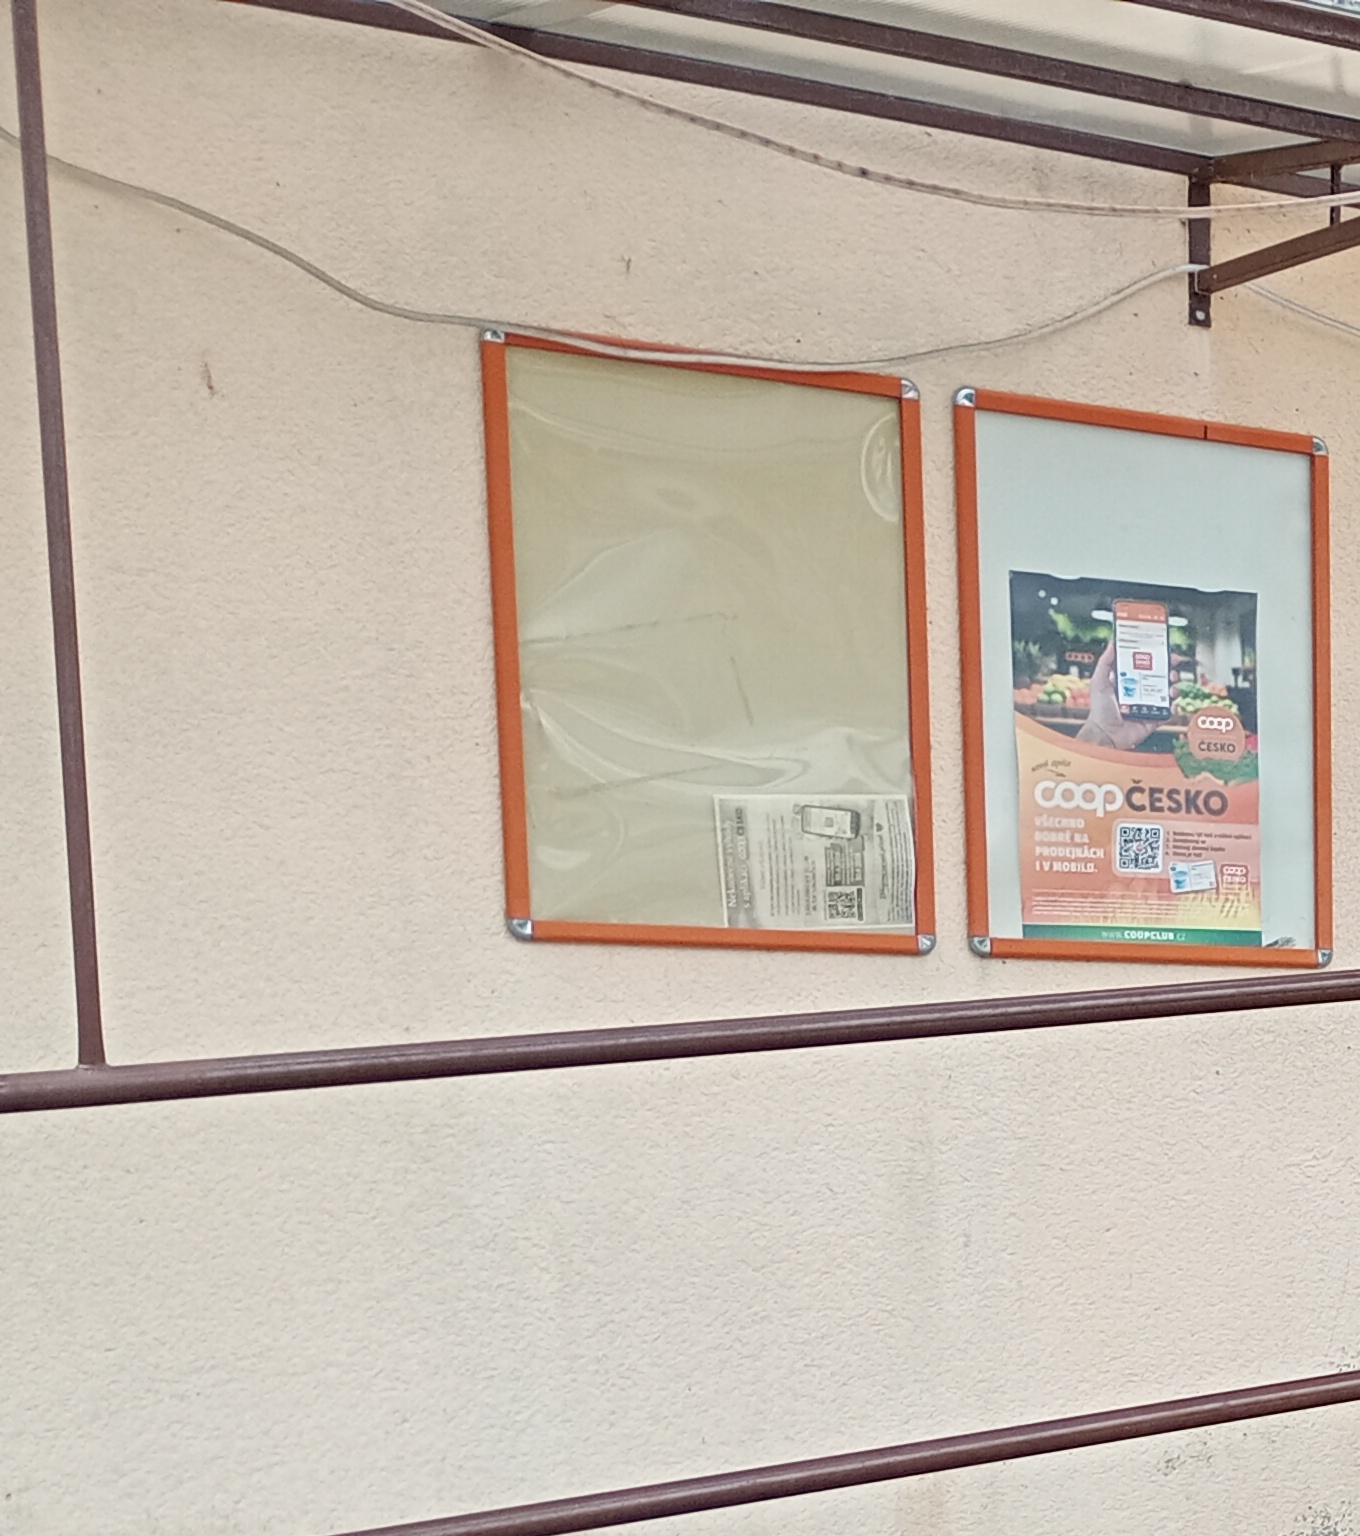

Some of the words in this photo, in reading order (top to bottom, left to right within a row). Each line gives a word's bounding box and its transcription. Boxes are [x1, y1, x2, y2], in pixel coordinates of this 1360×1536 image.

[1197, 716, 1234, 733] coop
[1197, 739, 1236, 754] ČESKO
[1034, 780, 1124, 818] coop
[1125, 779, 1228, 816] ČESKO
